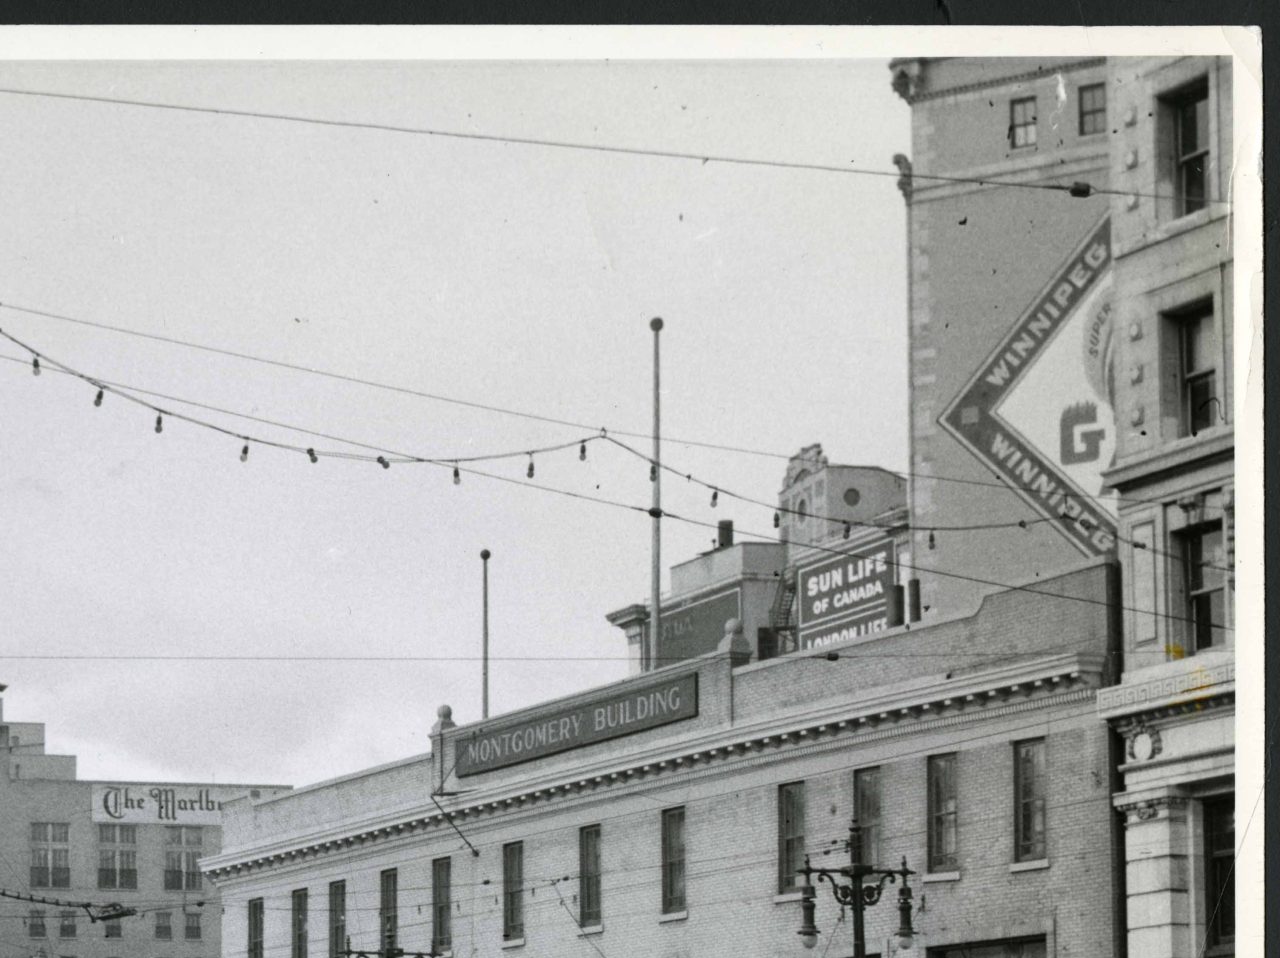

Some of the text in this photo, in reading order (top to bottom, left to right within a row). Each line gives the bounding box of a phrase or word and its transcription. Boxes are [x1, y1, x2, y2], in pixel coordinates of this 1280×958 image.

[986, 242, 1108, 386] WINNIPEG
[991, 432, 1115, 551] WINNIPEG
[807, 551, 887, 597] SUN LIFE
[813, 580, 883, 614] OF CANADA
[469, 686, 681, 765] MONTGOMERY BUILDING
[103, 786, 145, 819] The
